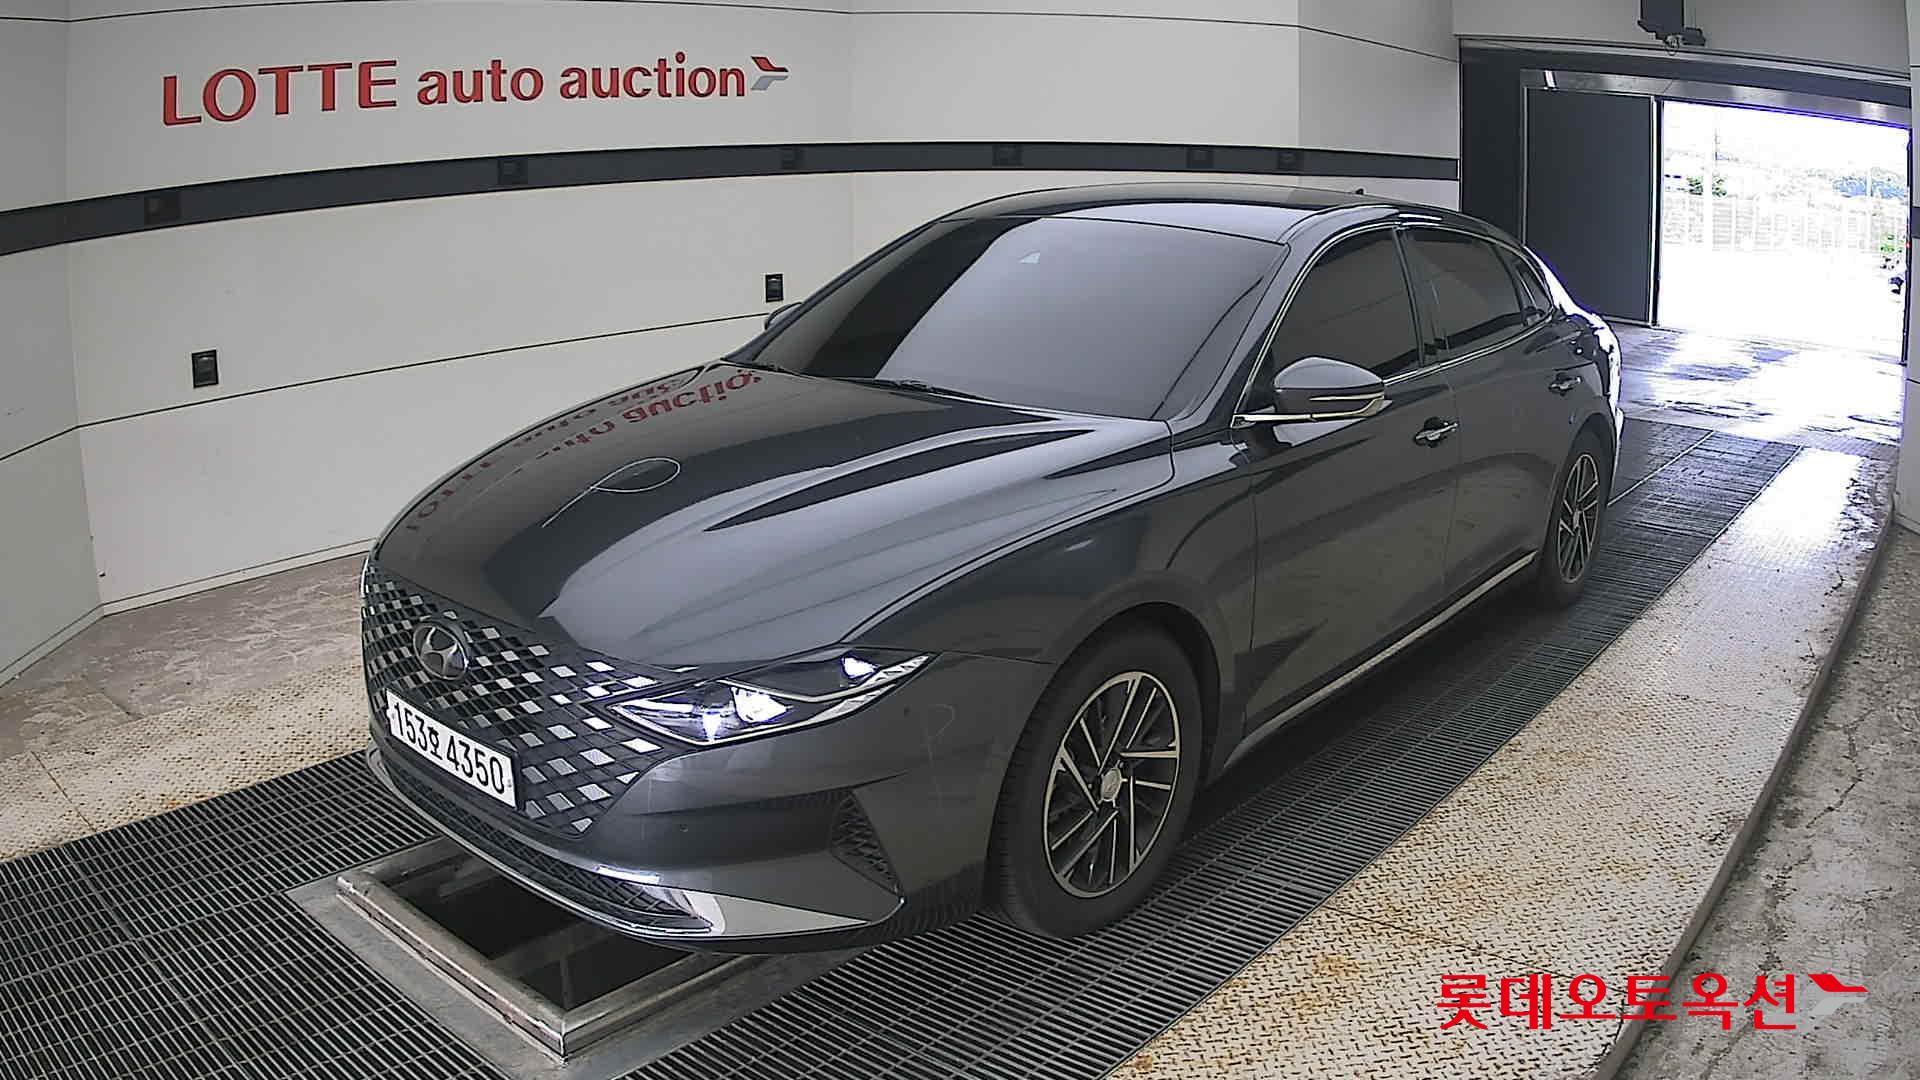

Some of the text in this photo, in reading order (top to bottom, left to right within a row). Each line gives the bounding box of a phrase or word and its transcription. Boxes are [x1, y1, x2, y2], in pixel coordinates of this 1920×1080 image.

[162, 51, 747, 127] LOTTE auto auction
